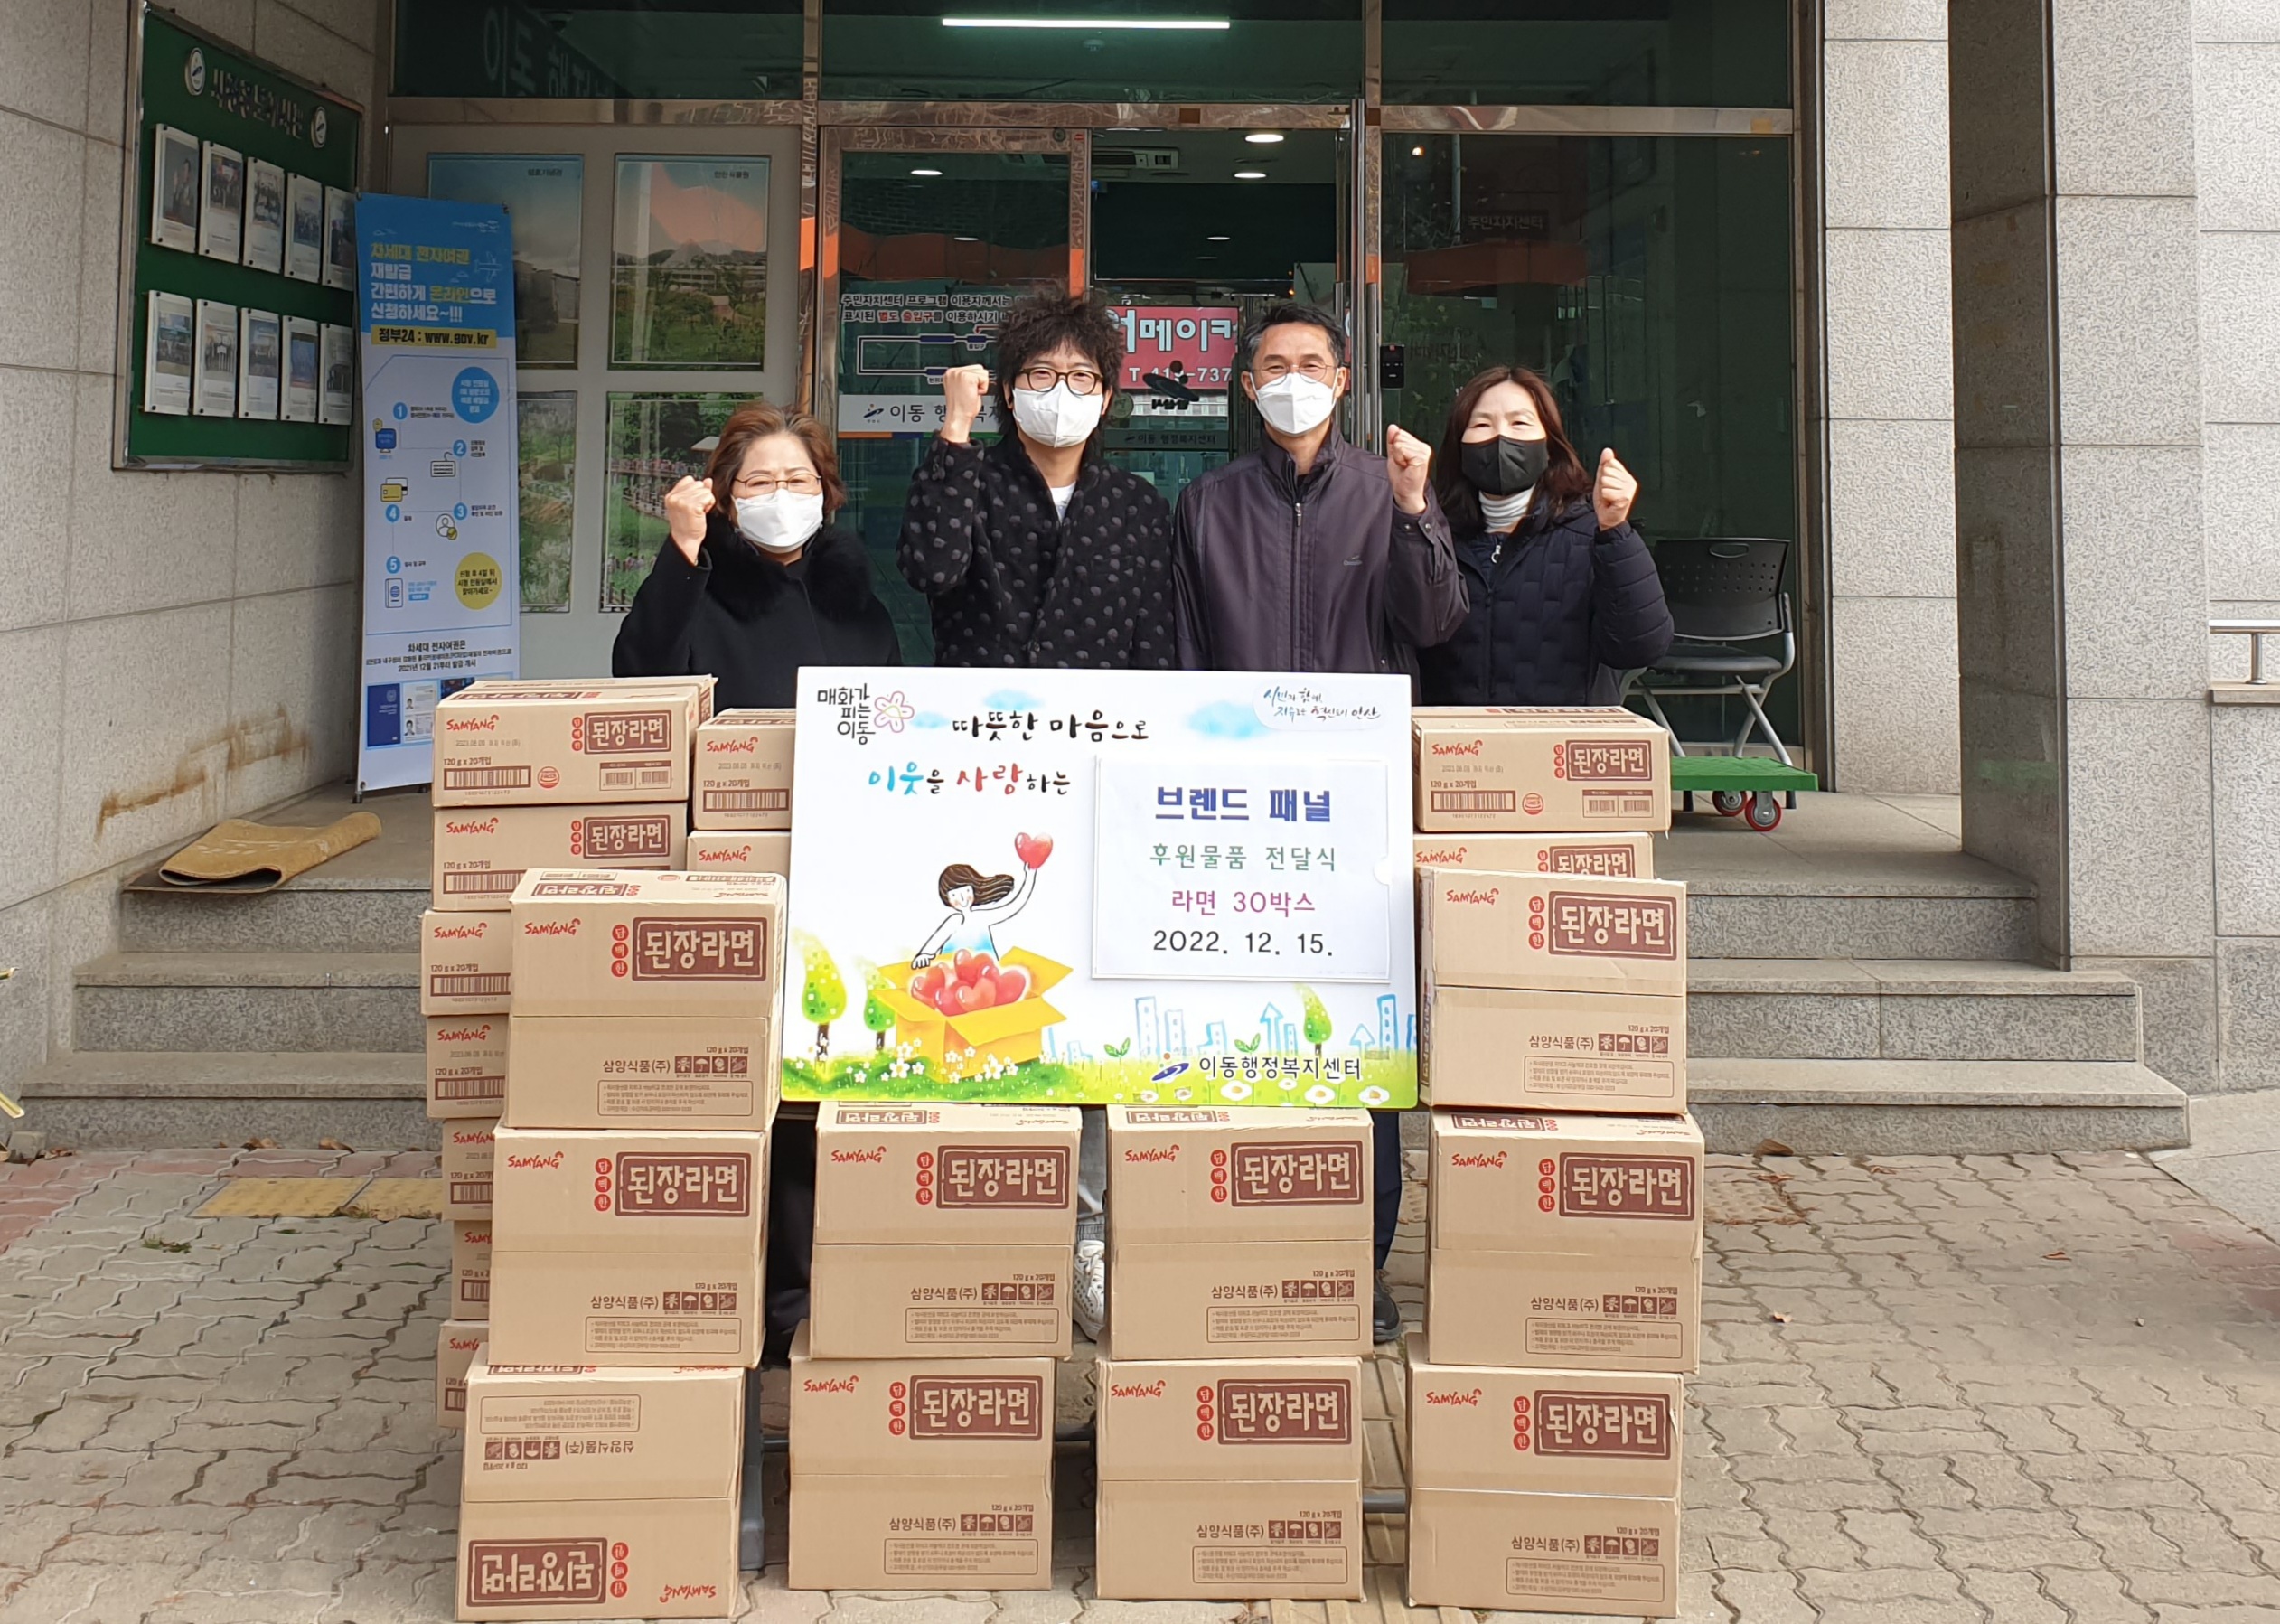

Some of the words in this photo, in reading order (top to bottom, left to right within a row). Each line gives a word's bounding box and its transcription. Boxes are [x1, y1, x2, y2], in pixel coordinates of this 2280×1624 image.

[371, 242, 412, 261] 차세대
[417, 245, 471, 265] 전자여권
[371, 262, 412, 280] 재발급
[371, 282, 427, 301] 간편하게
[429, 285, 497, 305] 온라인으로
[841, 294, 903, 306] 주민자치센터
[905, 295, 948, 307] 프로그램
[951, 295, 1011, 306] 이용자께서는
[371, 302, 463, 323] 신청하세요~!!!
[843, 311, 875, 323] 표시된
[878, 310, 899, 323] 별도
[903, 310, 943, 323] 출입구를
[946, 310, 998, 323] 이용하시기
[379, 327, 415, 343] 정부24
[424, 332, 489, 345] www.gov.kr
[1129, 367, 1141, 382] T
[889, 404, 925, 423] 이동
[1137, 434, 1156, 444] 이동
[408, 642, 430, 652] 차세대
[431, 639, 466, 652] 전자여권은
[817, 683, 870, 706] 매화가
[840, 703, 871, 720] 피는
[1351, 705, 1382, 720] 안산
[446, 715, 498, 732] SAMYANG
[591, 718, 664, 747] 된장라면
[952, 710, 1038, 742] 따뜻한
[1049, 709, 1149, 743] 마음으로
[837, 720, 876, 746] 이동
[707, 737, 758, 753] SAMYANG
[1431, 740, 1482, 756] SAMYANG
[444, 756, 455, 767] 120
[1573, 747, 1646, 774] 된장라면
[868, 761, 944, 795] 이웃을
[956, 763, 1071, 795] 사랑하는
[1431, 779, 1441, 789] 120
[1155, 786, 1250, 821] 브렌드
[1269, 788, 1331, 823] 패널
[446, 818, 498, 835] SAMYANG
[590, 822, 662, 851] 된장라면
[699, 845, 751, 862] SAMYANG
[1149, 842, 1247, 870] 후원물품
[1265, 846, 1336, 872] 전달식
[1416, 847, 1467, 864] SAMYANG
[1172, 889, 1216, 916] 라면
[1232, 891, 1316, 918] 30박스
[1446, 888, 1499, 906] SAMYANG
[434, 922, 487, 939] SAMYANG
[524, 918, 580, 936] SAMYANG
[1559, 904, 1665, 946] 된장라면
[645, 928, 755, 970] 된장라면
[1152, 929, 1229, 955] 2022.
[1244, 931, 1281, 956] 12.
[1297, 932, 1334, 957] 15.
[437, 1025, 491, 1042] SAMYANG
[1528, 1034, 1595, 1051] 삼양식품(주)
[602, 1057, 671, 1074] 삼양식품(주)
[1198, 1056, 1363, 1081] 이동행정복지센터
[453, 1131, 495, 1145] SAMYAN
[508, 1151, 564, 1169] SAMYANG
[831, 1146, 887, 1164] SAMYANG
[1124, 1144, 1180, 1163] SAMYANG
[1452, 1150, 1507, 1169] SAMYANG
[949, 1158, 1057, 1197] 된장라면
[1243, 1151, 1352, 1195] 된장라면
[627, 1164, 738, 1206] 된장라면
[1572, 1166, 1683, 1207] 된장라면
[464, 1231, 492, 1244] SAMY
[910, 1286, 979, 1301] 삼양식품(주)
[1211, 1283, 1279, 1300] 삼양식품(주)
[590, 1294, 660, 1310] 삼양식품(주)
[1530, 1296, 1600, 1312] 삼양식품(주)
[803, 1375, 859, 1394] SAMYANG
[1111, 1380, 1166, 1398] SAMYANG
[1426, 1388, 1482, 1407] SAMYANG
[922, 1387, 1031, 1428] 된장라면
[1229, 1391, 1339, 1432] 된장라면
[1546, 1403, 1658, 1445] 된장라면
[564, 1439, 635, 1455] 삼양식품(주)
[889, 1517, 957, 1532] 삼양식품(주)
[1196, 1523, 1265, 1539] 삼양식품(주)
[1511, 1535, 1581, 1553] 삼양식품(주)
[482, 1550, 595, 1595] 된장라면
[659, 1584, 717, 1603] SAMYANG
